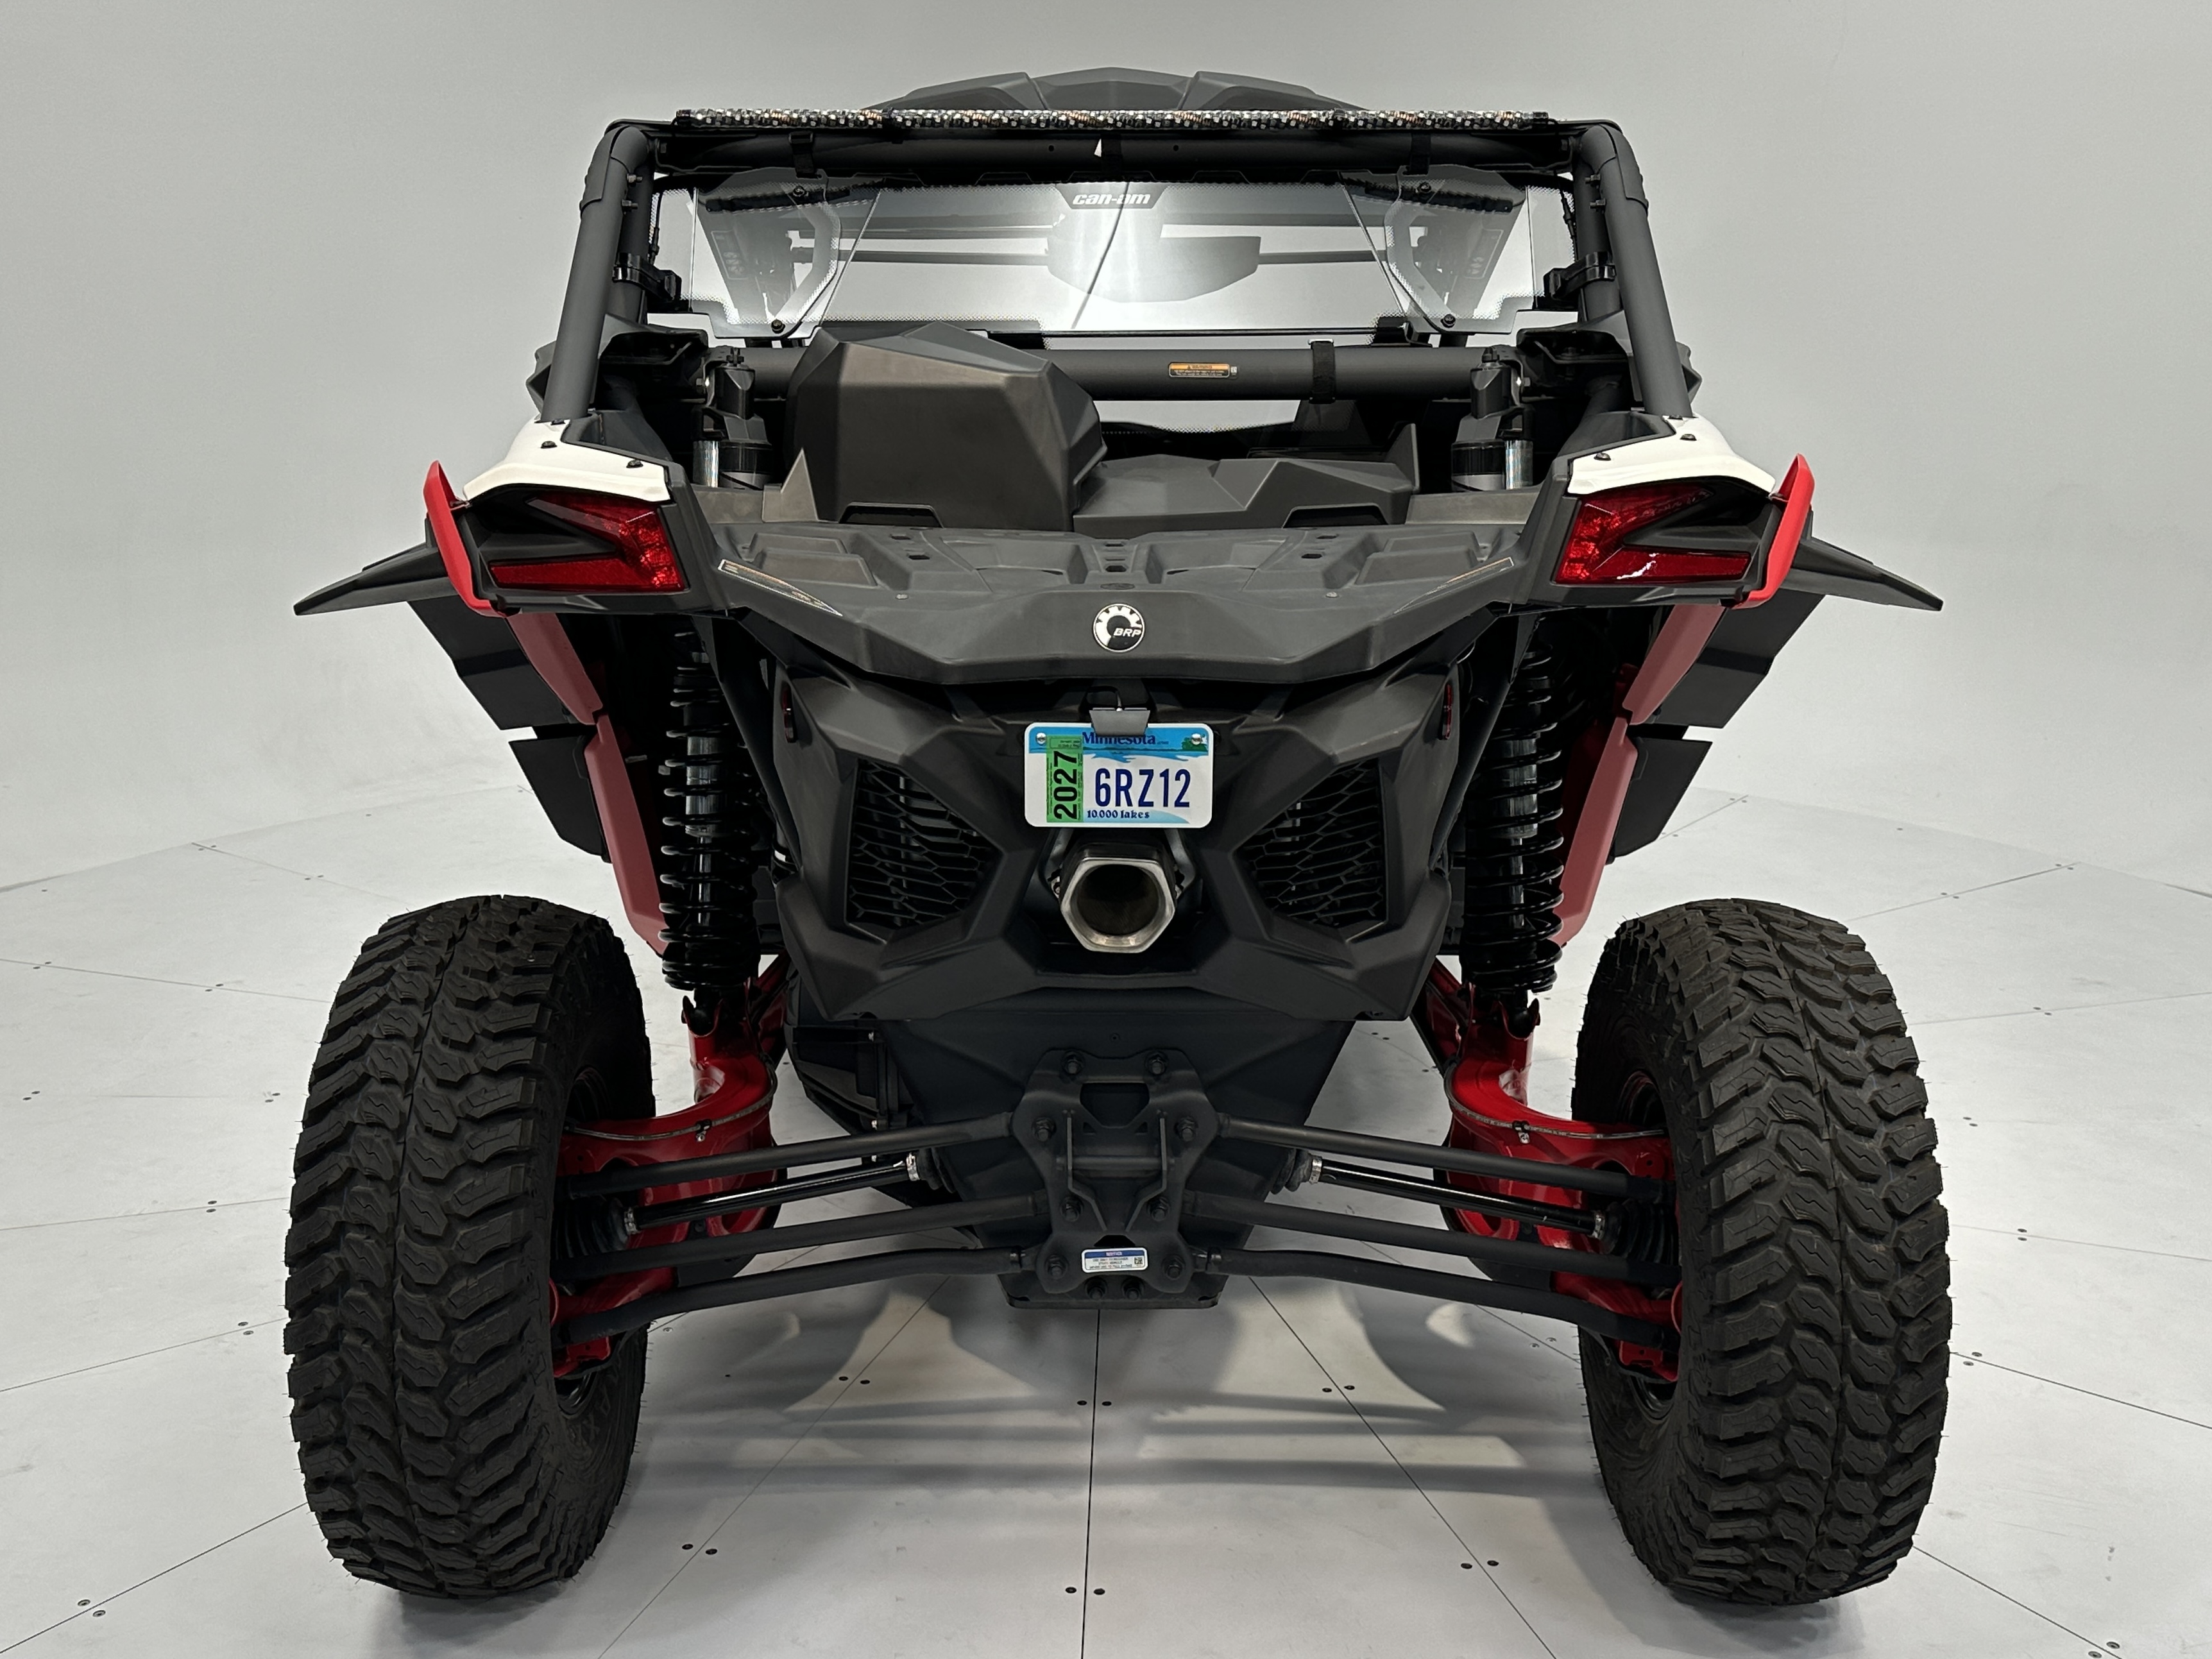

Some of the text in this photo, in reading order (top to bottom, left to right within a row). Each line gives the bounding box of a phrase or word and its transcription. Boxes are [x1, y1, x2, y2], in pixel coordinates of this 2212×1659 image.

[1072, 194, 1151, 205] can-am
[1113, 627, 1142, 638] BRP
[1082, 731, 1156, 745] Minnesota
[1053, 751, 1078, 820] 2027
[1094, 768, 1191, 808] 6RZ12
[1120, 809, 1150, 819] lakes
